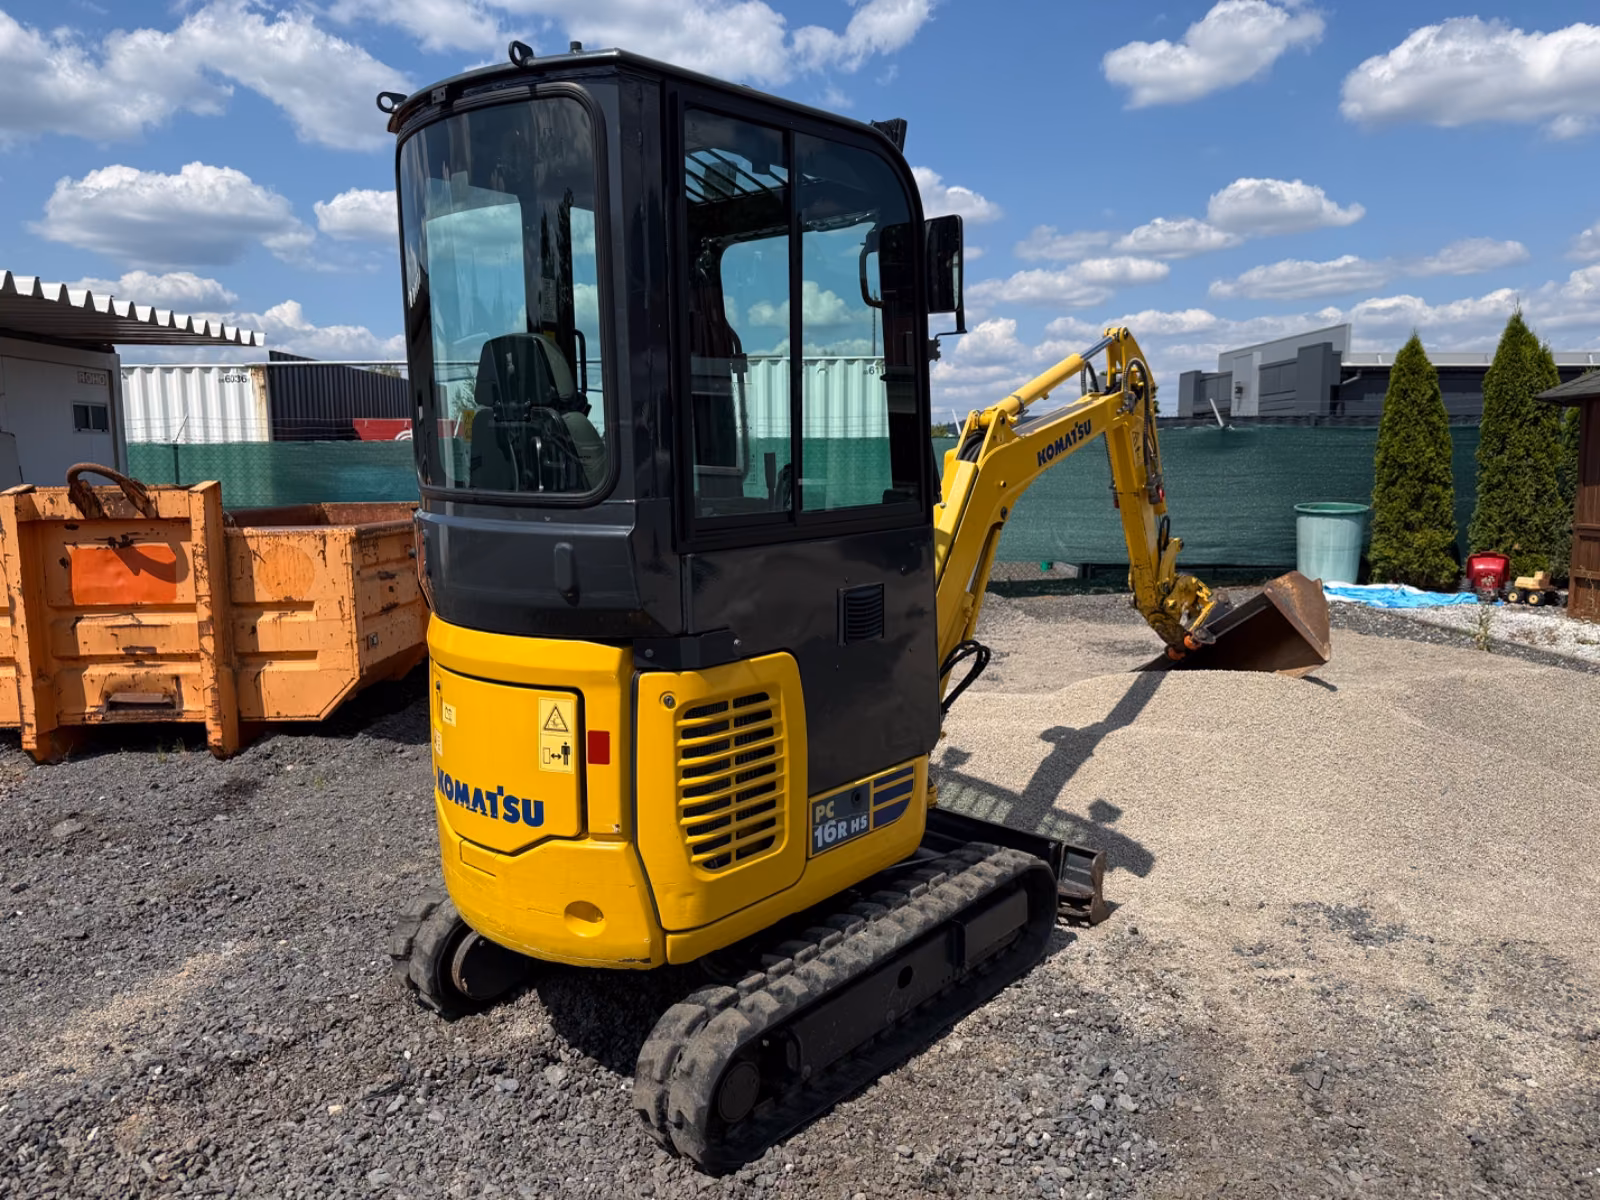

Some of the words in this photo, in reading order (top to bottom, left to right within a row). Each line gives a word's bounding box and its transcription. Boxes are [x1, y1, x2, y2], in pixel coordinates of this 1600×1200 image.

[1037, 418, 1092, 467] KOMATSU
[437, 765, 544, 828] KOMATSU
[815, 800, 835, 823] PC
[814, 819, 848, 848] 16R
